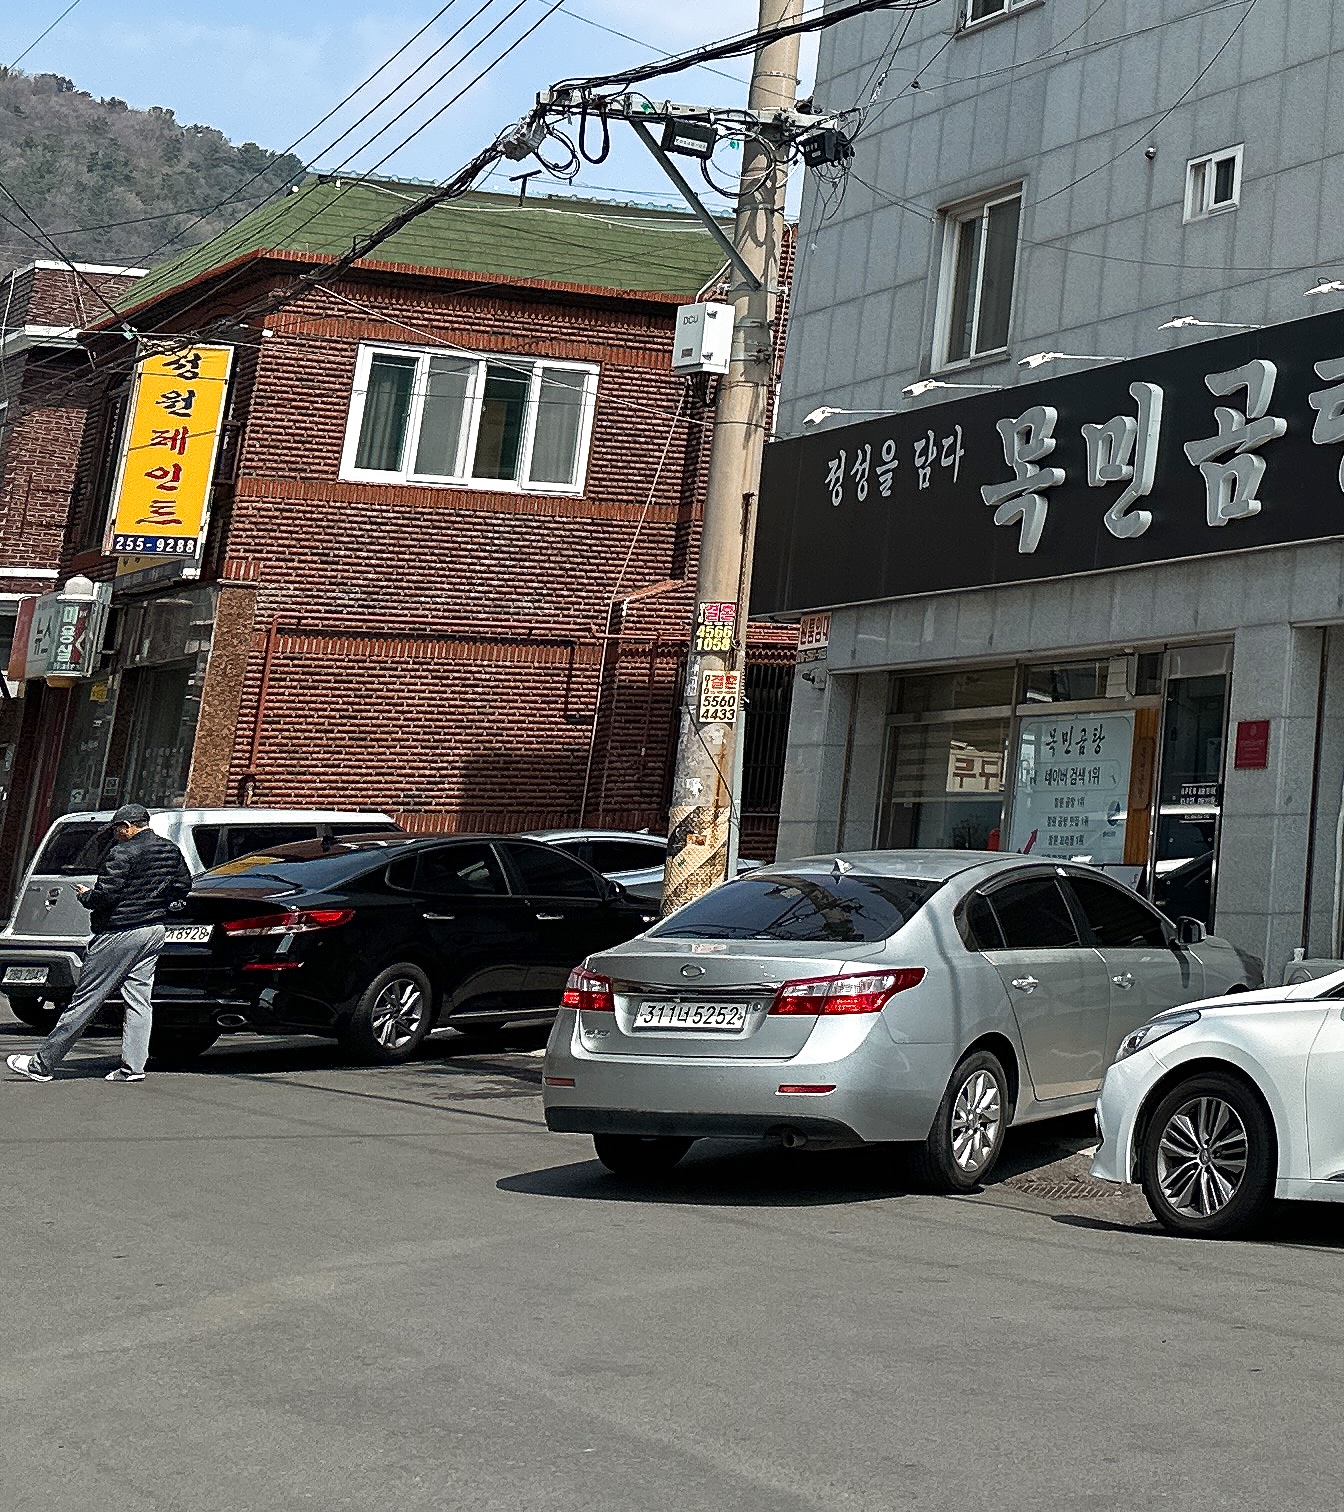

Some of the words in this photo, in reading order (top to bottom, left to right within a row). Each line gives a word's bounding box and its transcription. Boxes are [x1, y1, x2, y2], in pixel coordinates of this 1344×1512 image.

[825, 439, 898, 506] 정성을
[913, 424, 964, 490] 담다
[115, 536, 195, 553] 255-9288
[696, 625, 733, 638] 4566
[696, 638, 731, 651] 1058
[703, 696, 735, 707] 5560
[701, 709, 735, 720] 4433
[692, 1006, 739, 1026] 5252
